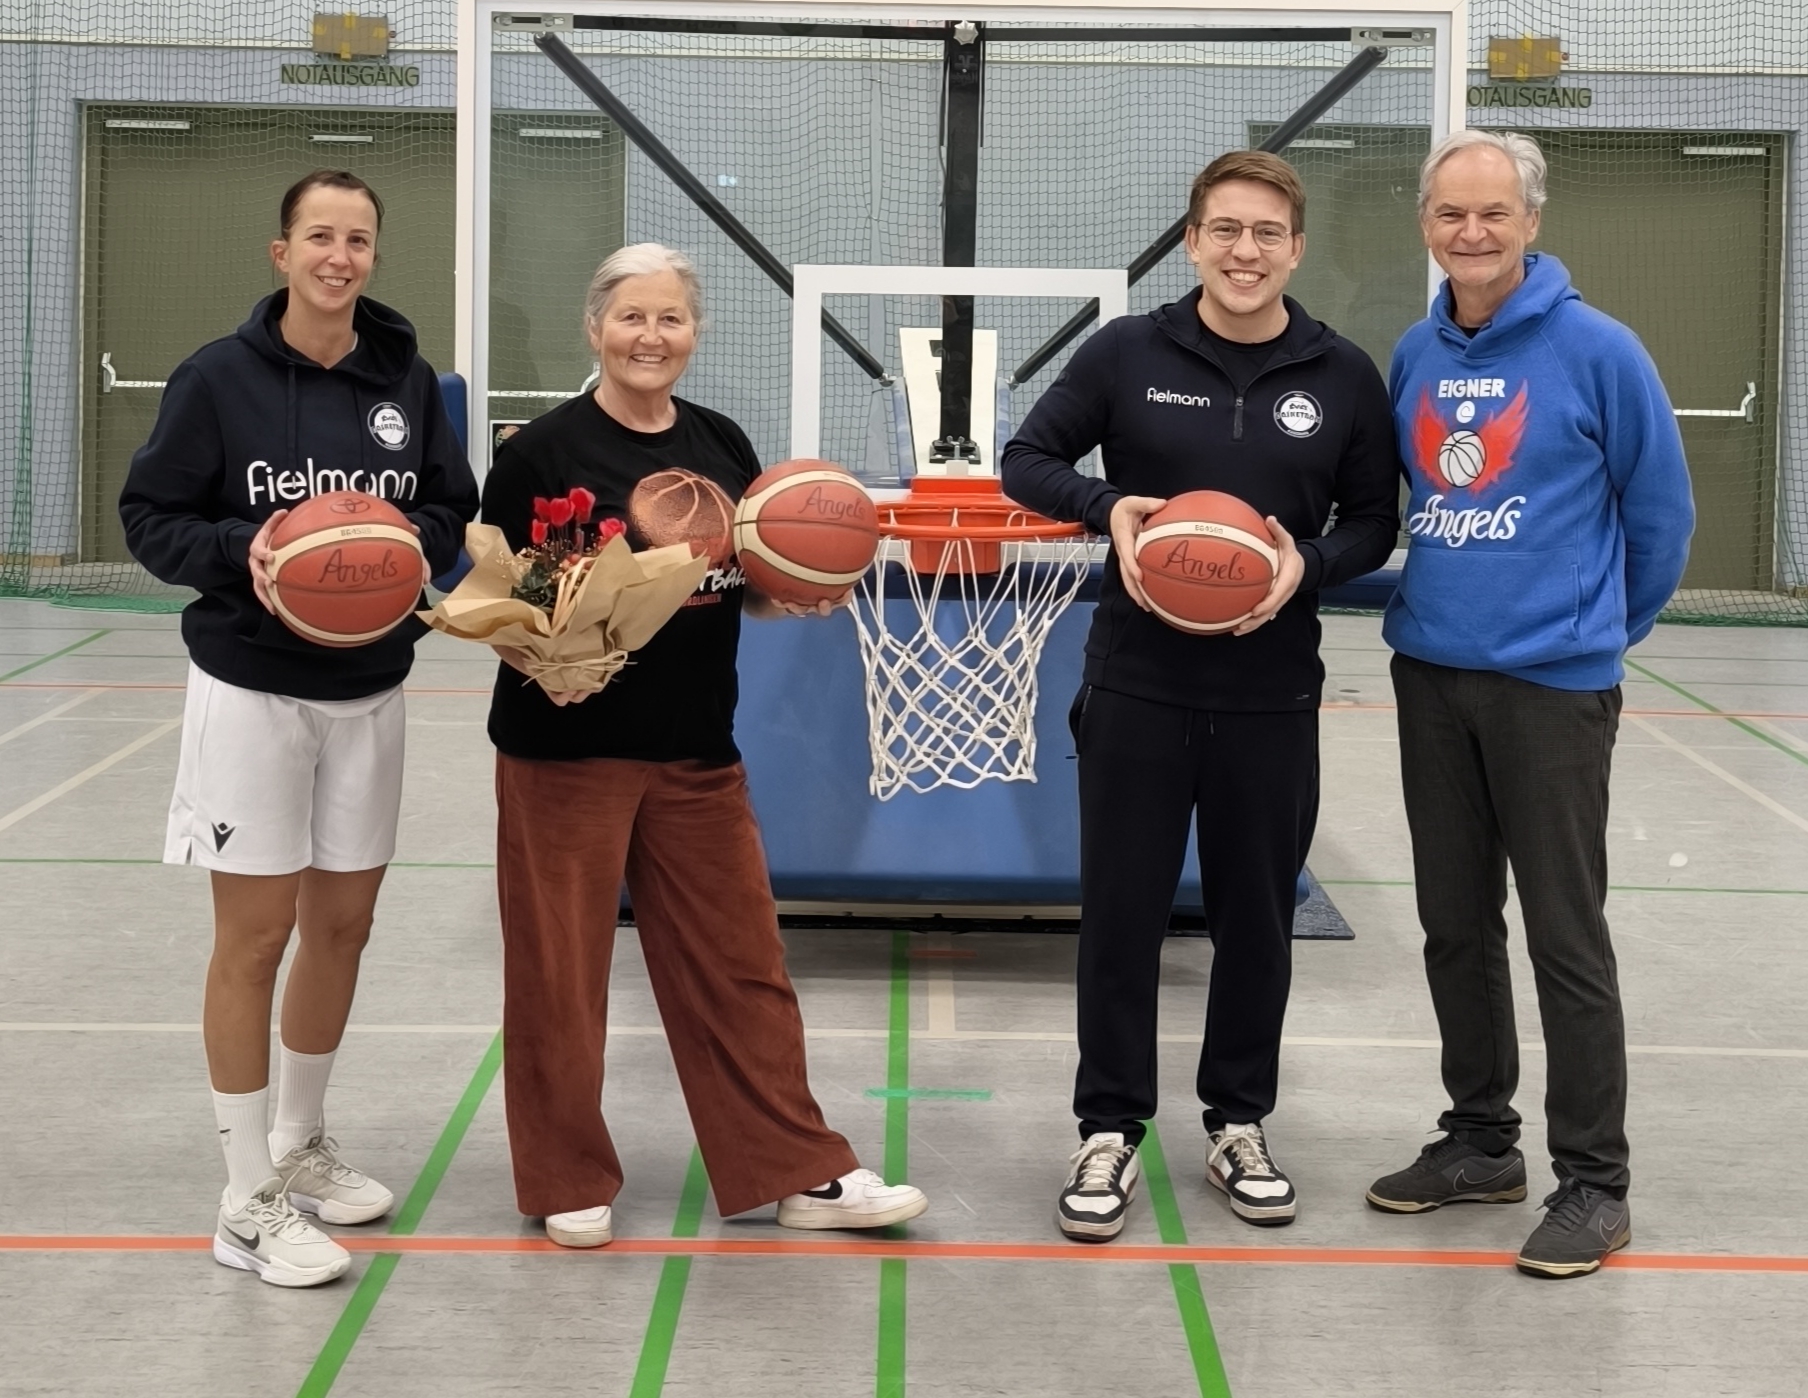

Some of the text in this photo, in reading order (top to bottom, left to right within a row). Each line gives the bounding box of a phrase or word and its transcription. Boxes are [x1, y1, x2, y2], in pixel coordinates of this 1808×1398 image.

[281, 63, 420, 87] NOTAUSGANG
[1467, 86, 1593, 108] OTAUSGANG
[1438, 378, 1506, 398] EIGNER
[798, 485, 867, 521] Angels
[1409, 494, 1527, 548] Angels
[318, 548, 399, 589] Angels
[1162, 539, 1246, 582] Angels
